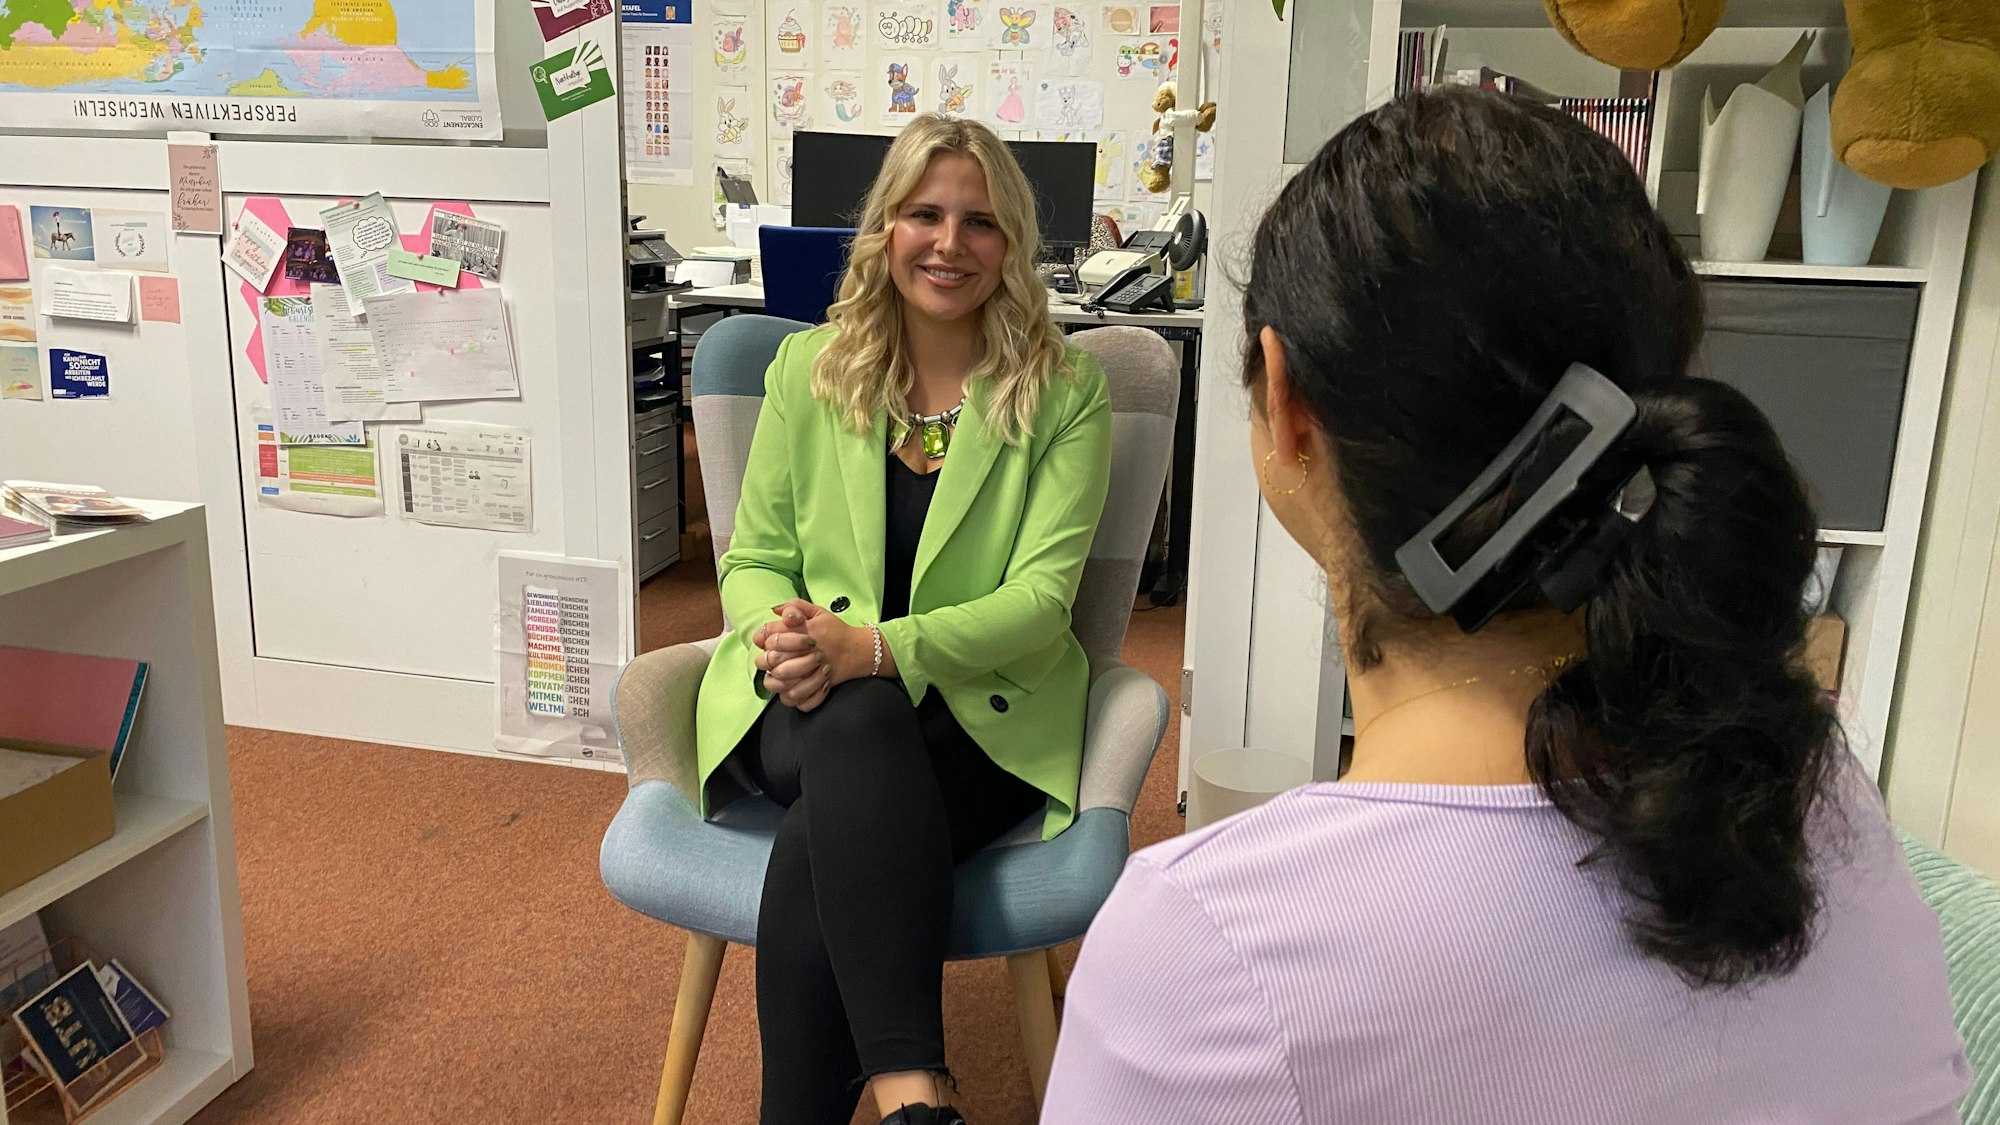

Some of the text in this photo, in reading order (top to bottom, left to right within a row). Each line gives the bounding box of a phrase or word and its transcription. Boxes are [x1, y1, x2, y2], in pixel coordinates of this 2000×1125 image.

[73, 100, 297, 122] PERSPEKTIVEN WECHSELN!
[177, 192, 210, 208] früher
[69, 362, 81, 370] SO
